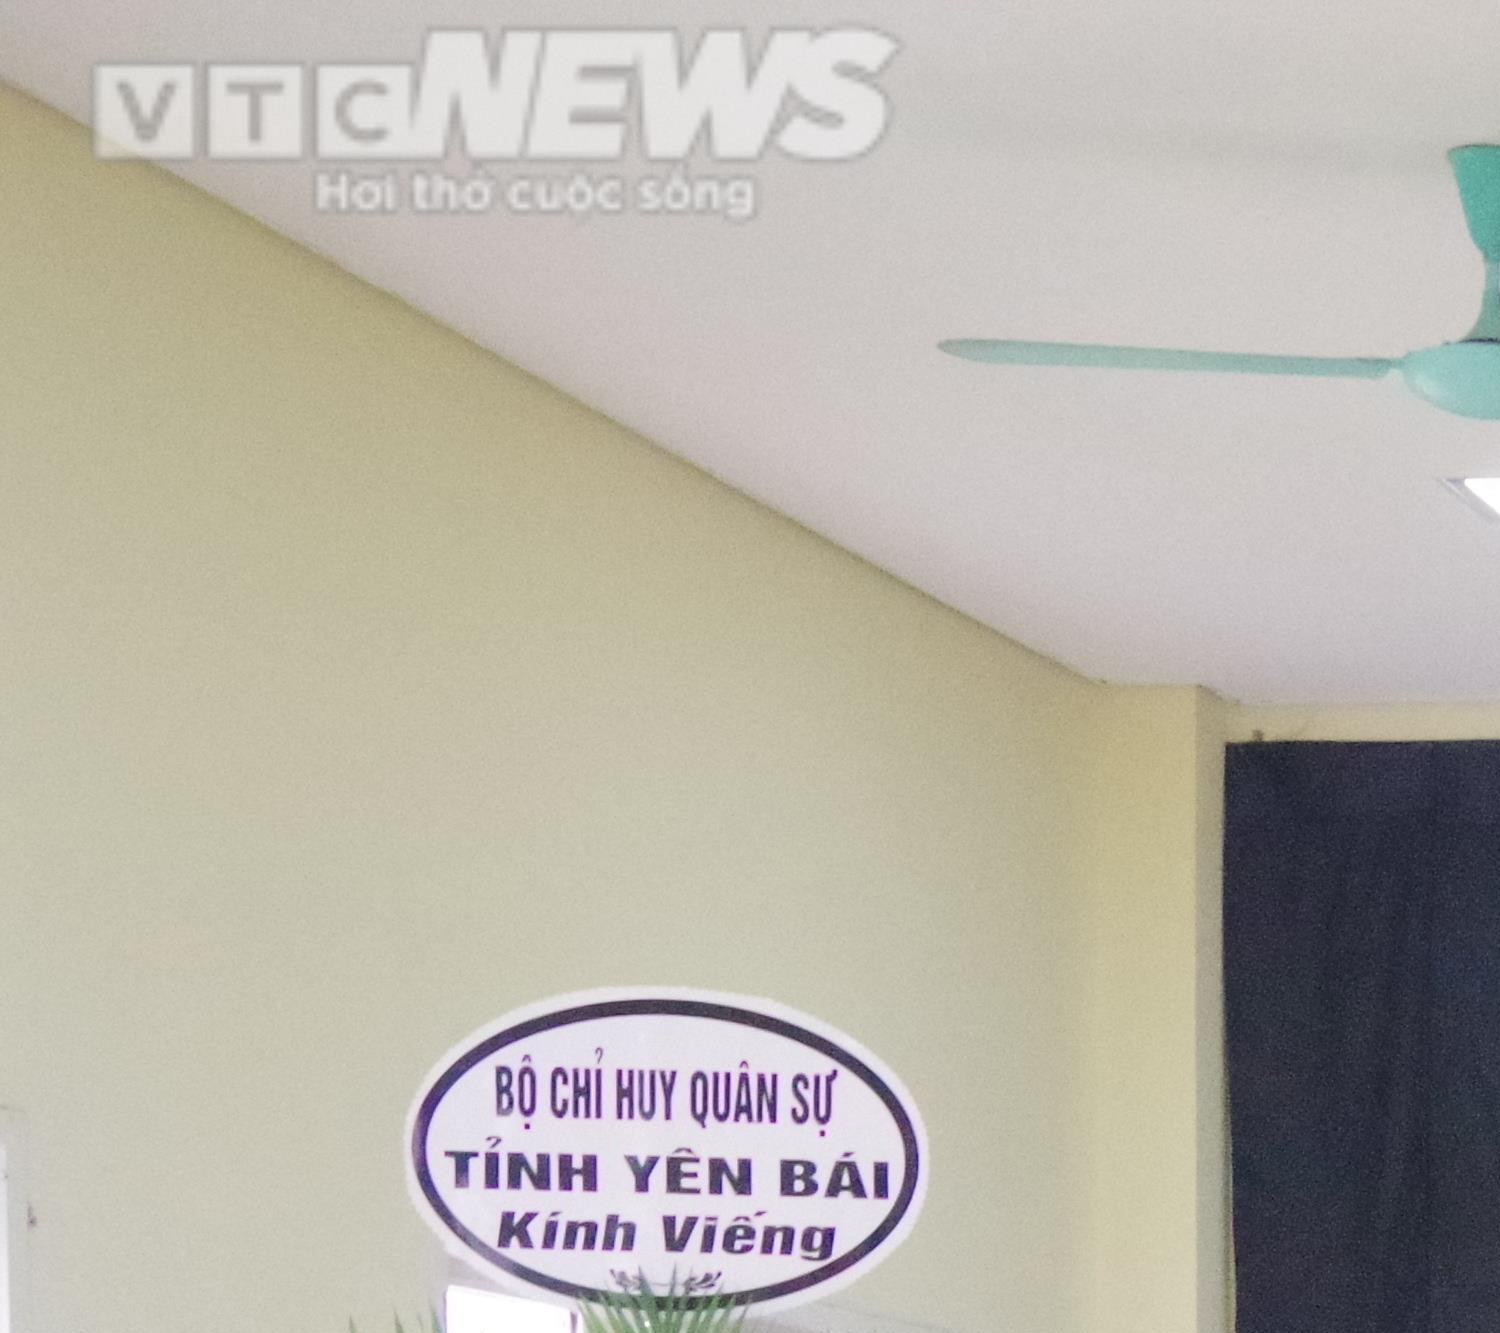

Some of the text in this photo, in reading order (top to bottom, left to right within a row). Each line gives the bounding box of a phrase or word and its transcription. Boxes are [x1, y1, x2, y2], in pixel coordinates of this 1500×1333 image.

[494, 1047, 838, 1138] BỘ CHỈ HUY QUÂN SỰ
[444, 1137, 889, 1200] TỈNH YÊN BÁI
[497, 1211, 836, 1262] Kính Viếng
